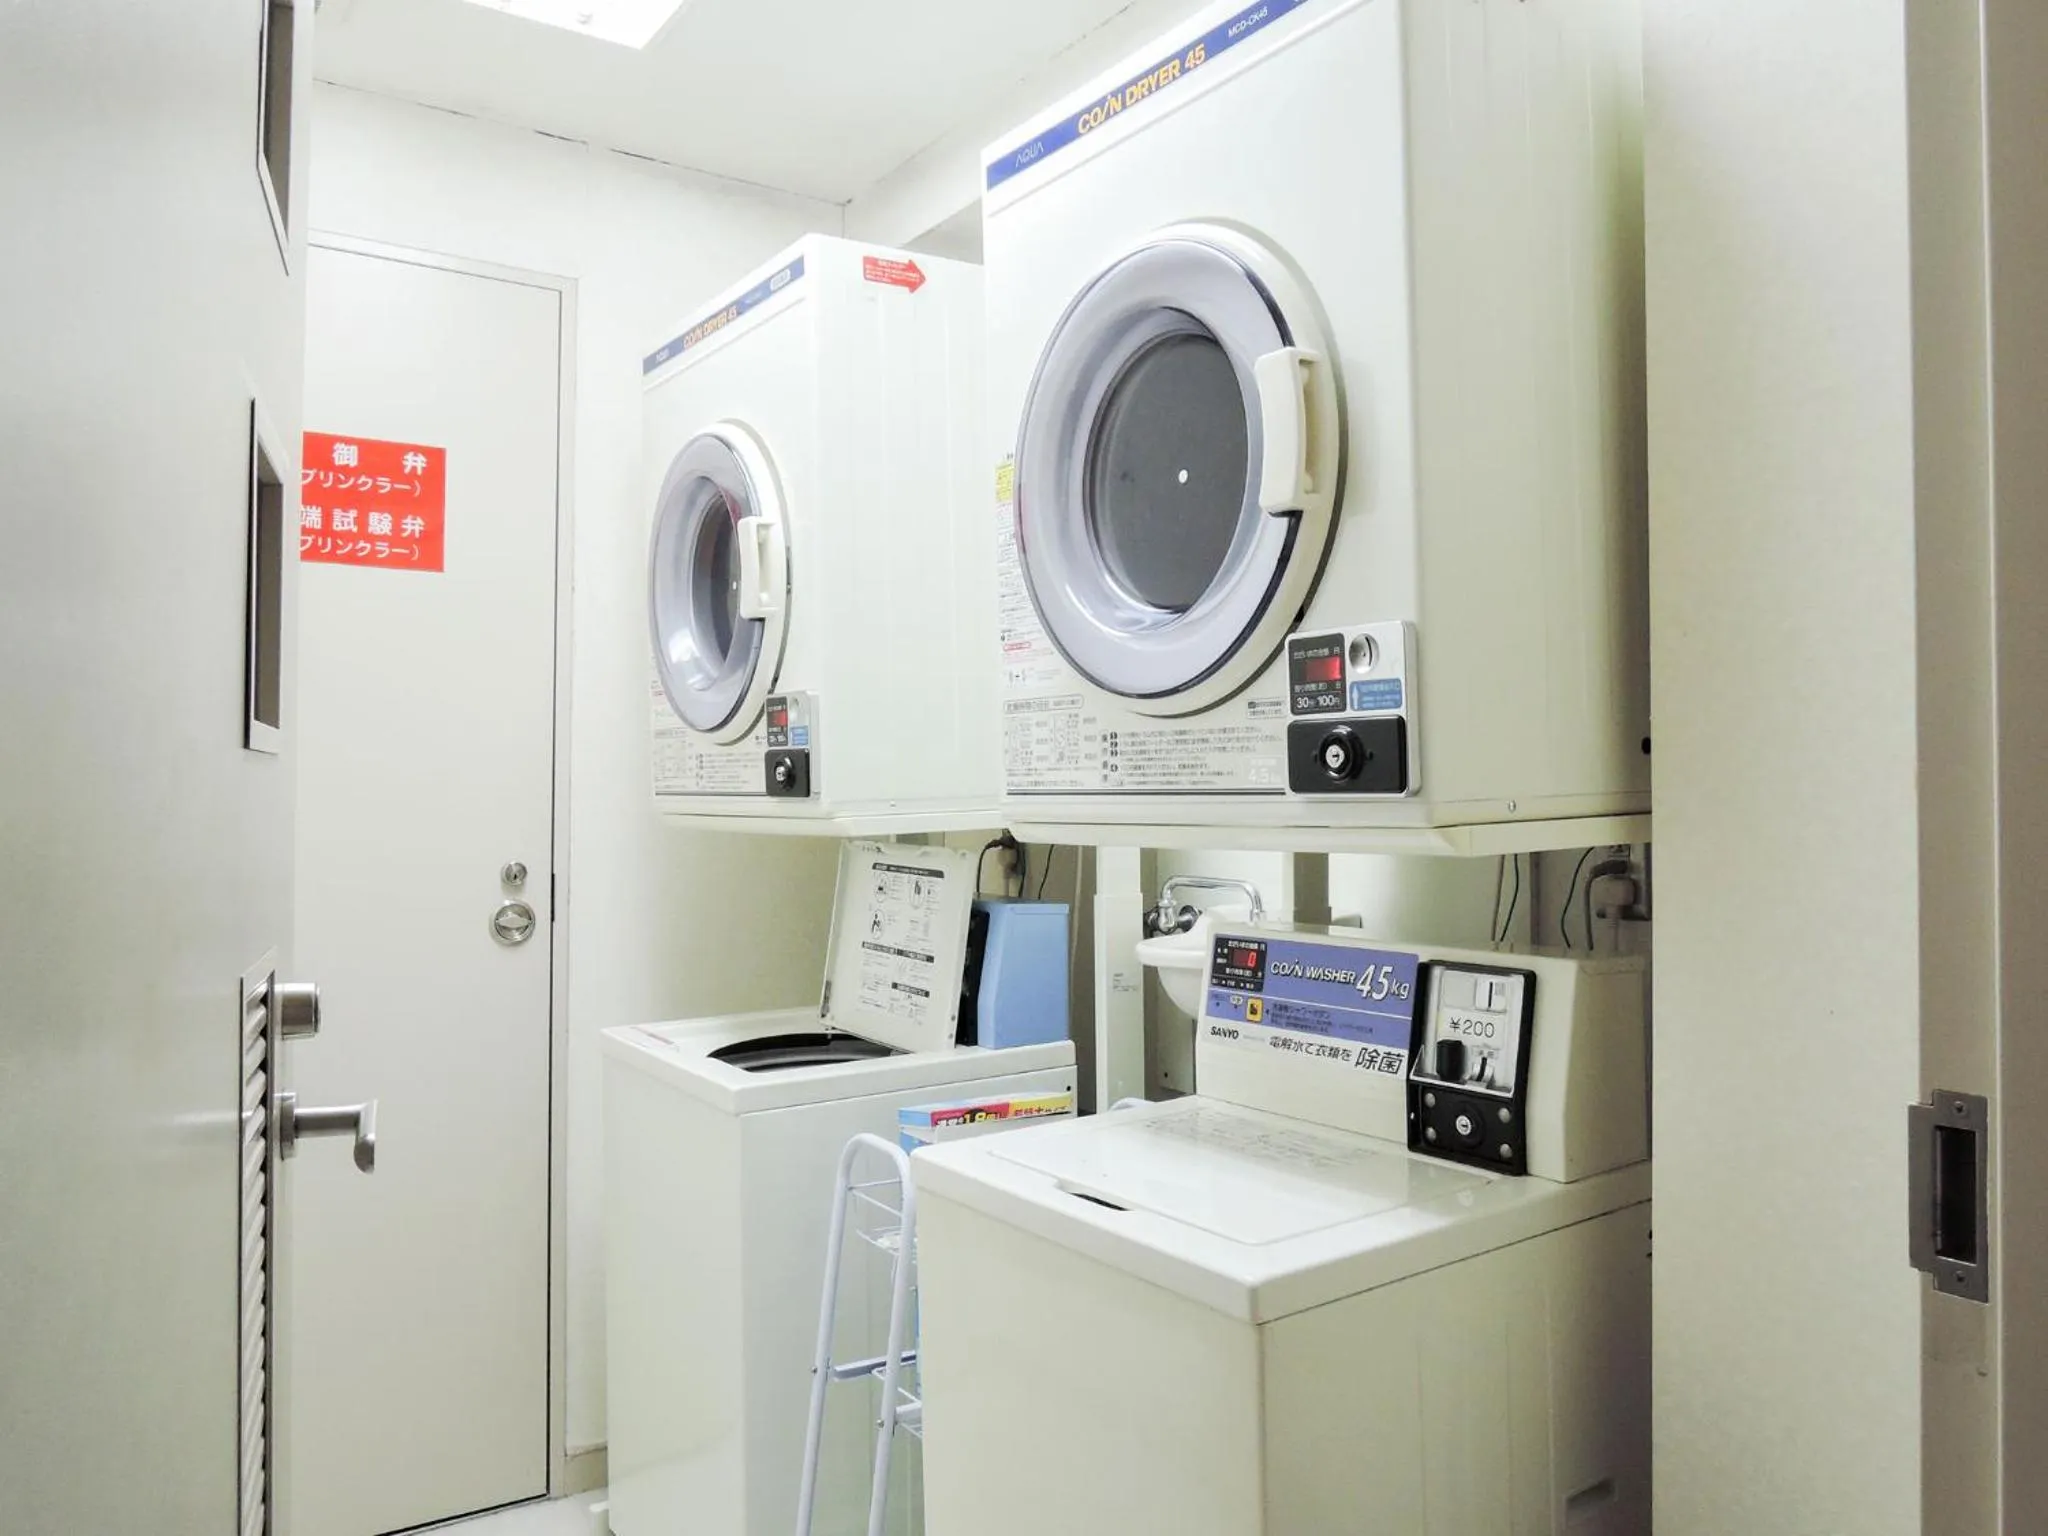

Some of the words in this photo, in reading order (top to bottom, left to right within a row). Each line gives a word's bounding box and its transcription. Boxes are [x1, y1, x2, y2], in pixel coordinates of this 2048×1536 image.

[1015, 142, 1045, 167] AQUA
[1126, 63, 1180, 106] DRYER
[1185, 44, 1206, 70] 45
[1247, 951, 1257, 968] 0
[1305, 967, 1356, 985] WASHER
[1210, 1026, 1239, 1040] SANYO
[1449, 1017, 1495, 1038] ¥200
[1354, 1046, 1405, 1075] 除菌
